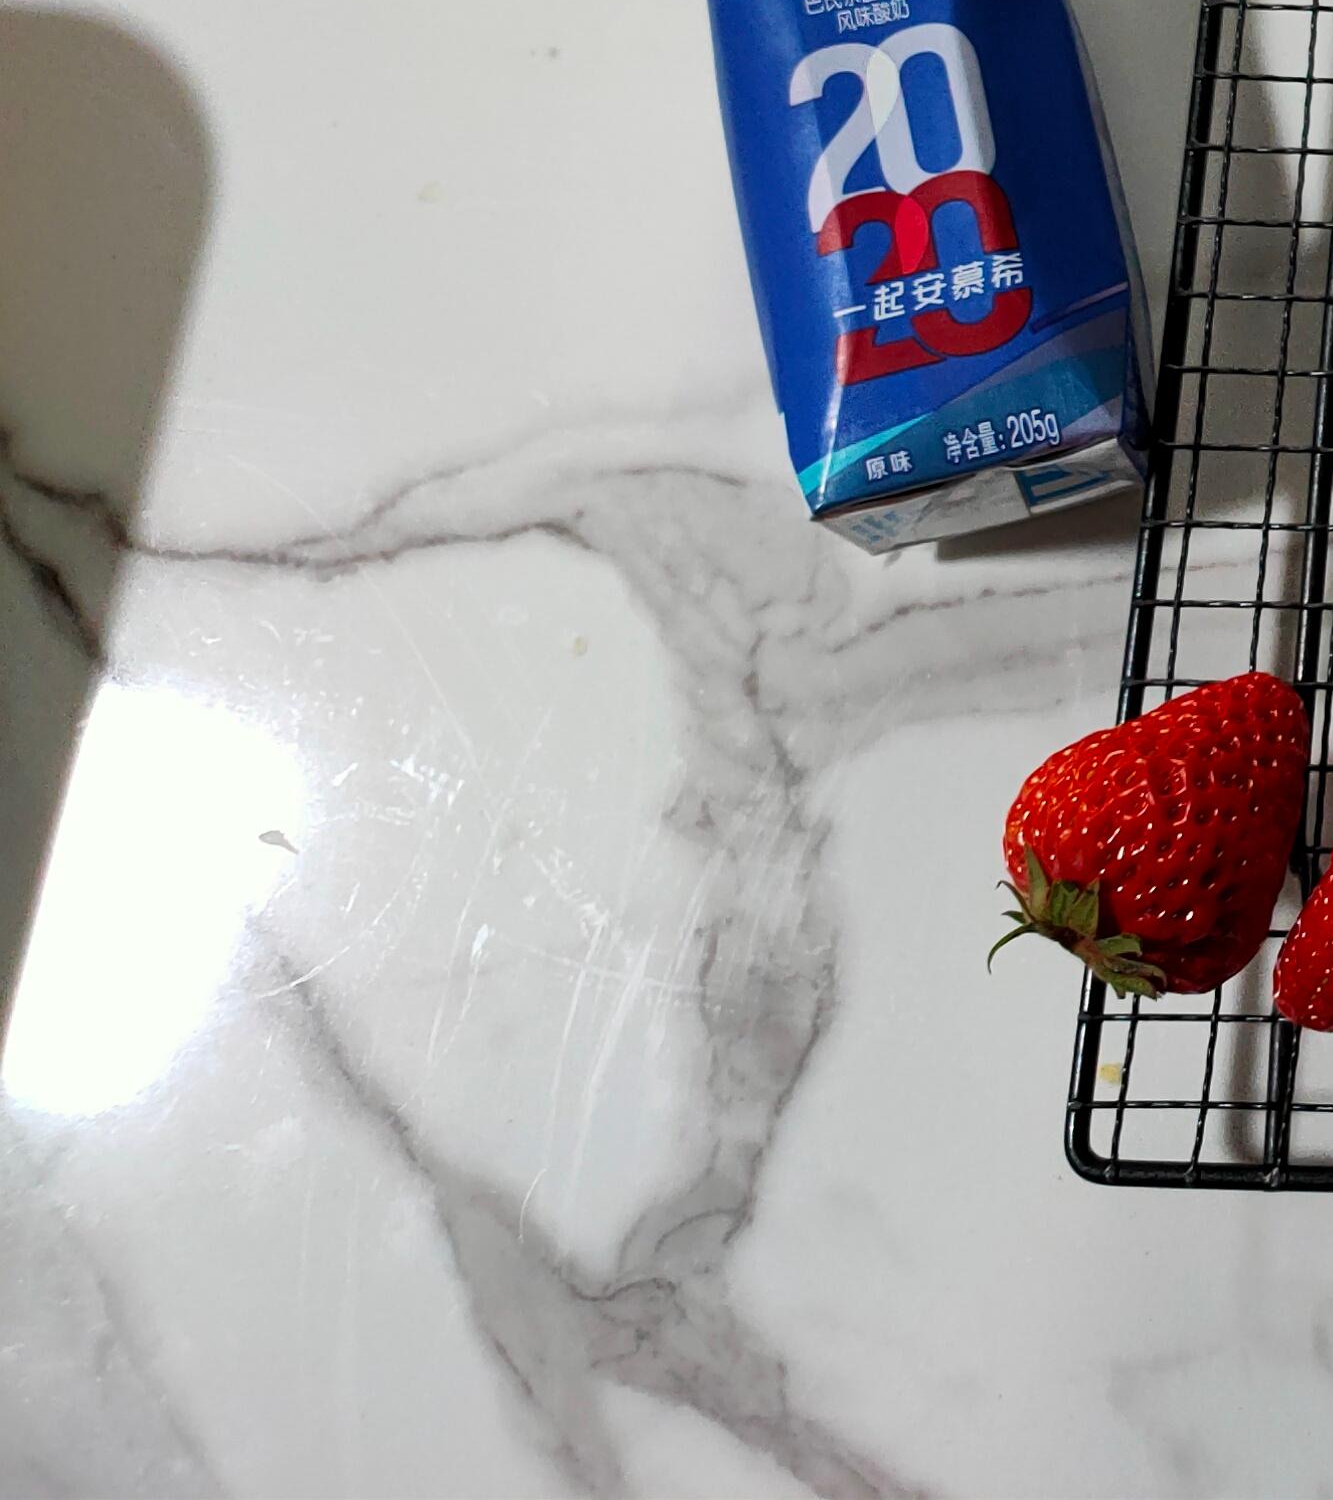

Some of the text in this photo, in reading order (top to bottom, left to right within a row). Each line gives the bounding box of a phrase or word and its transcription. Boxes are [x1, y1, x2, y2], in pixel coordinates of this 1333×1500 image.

[789, 23, 996, 234] 20
[832, 252, 1026, 322] 一起安慕希
[866, 450, 913, 481] 原味
